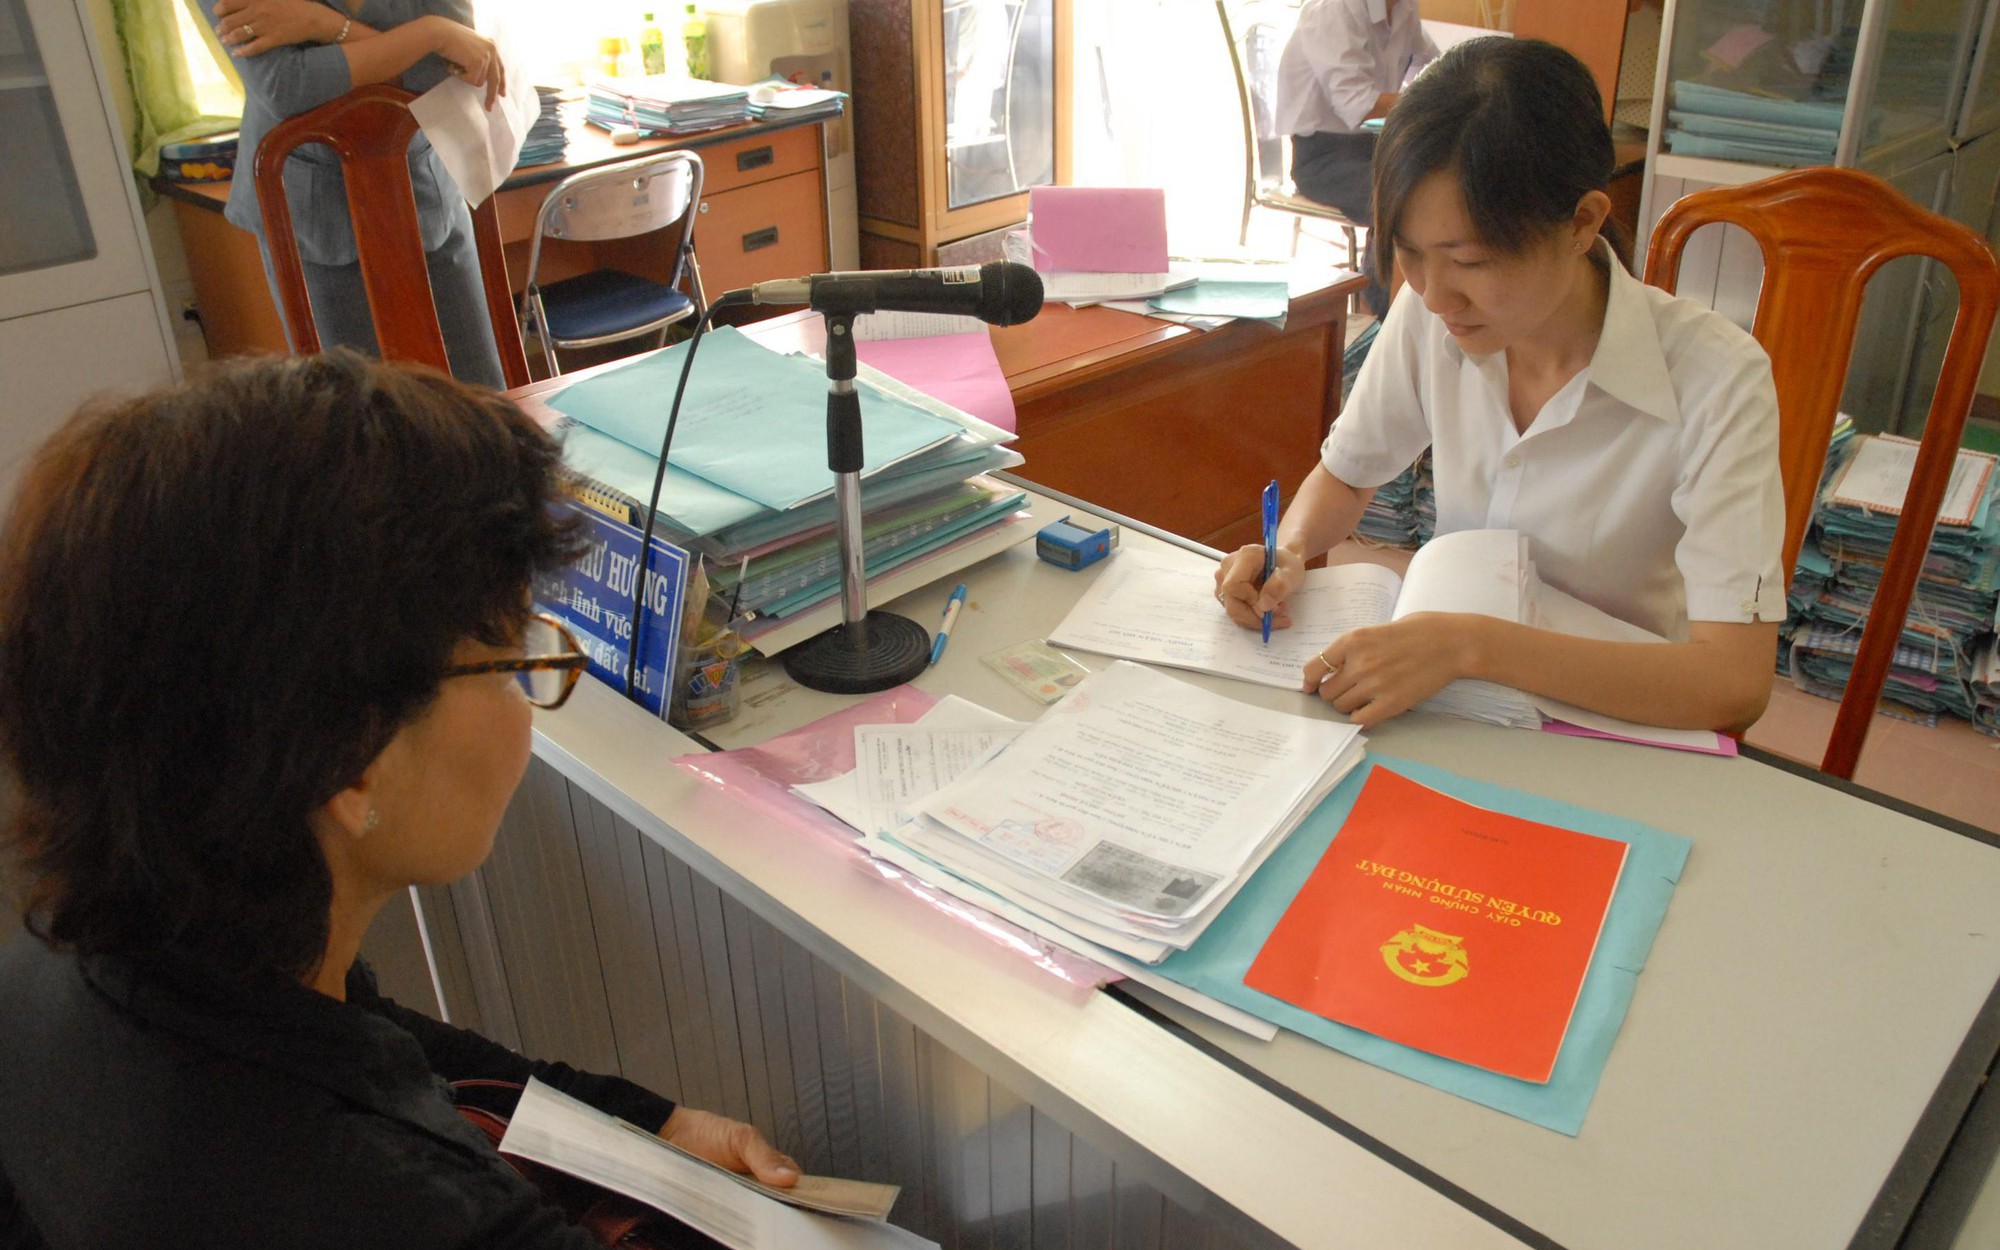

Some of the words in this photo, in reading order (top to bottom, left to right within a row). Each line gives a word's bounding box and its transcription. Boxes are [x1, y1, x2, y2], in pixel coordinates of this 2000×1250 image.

[574, 540, 607, 582] HƯ
[1355, 859, 1398, 877] ĐẤT
[1398, 870, 1454, 897] DỤNG
[1429, 895, 1480, 914] CHỨNG
[1454, 887, 1486, 905] SỬ
[1486, 910, 1521, 927] GIẤY
